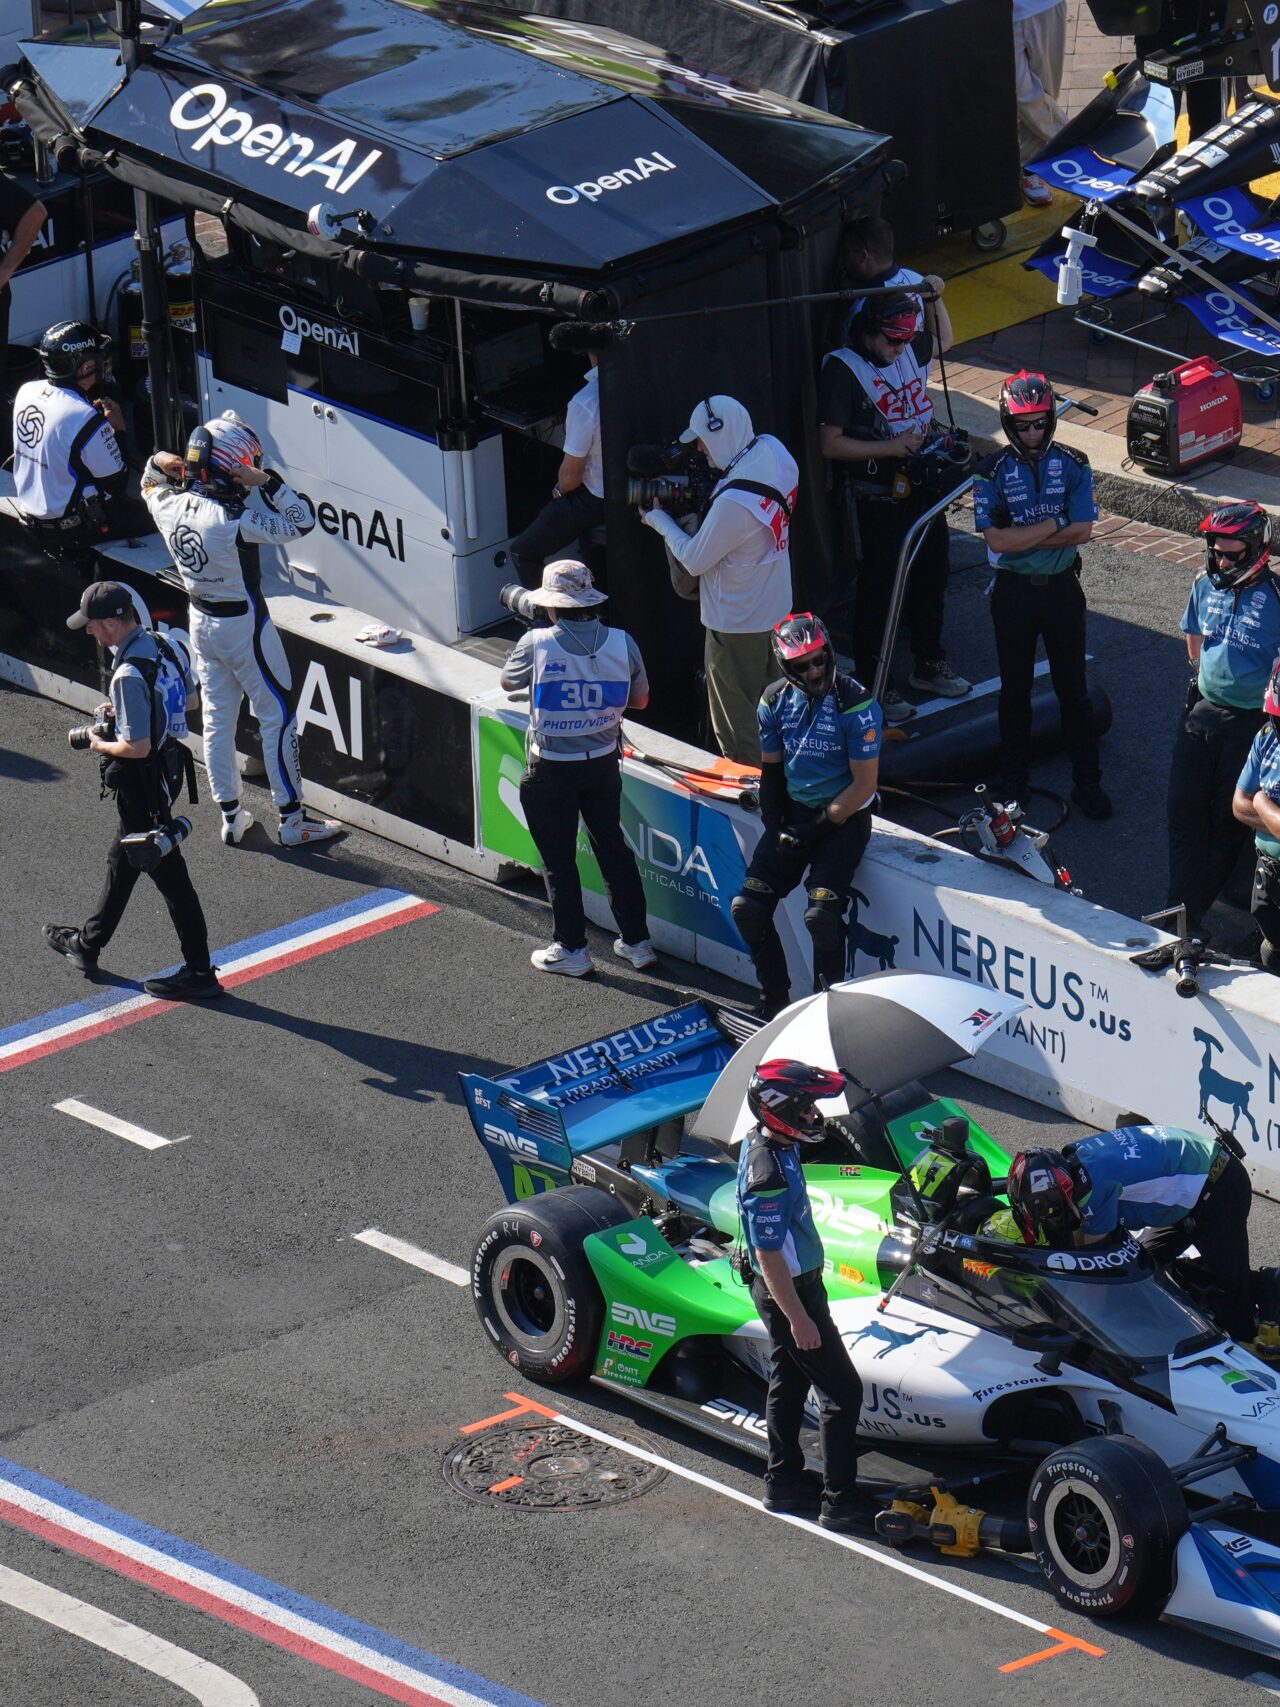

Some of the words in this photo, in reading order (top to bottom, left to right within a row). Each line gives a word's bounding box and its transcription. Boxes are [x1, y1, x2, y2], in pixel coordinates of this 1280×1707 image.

[1177, 66, 1203, 80] HYBRID
[169, 83, 383, 194] OpenAI
[545, 151, 677, 205] OpenAI
[278, 305, 360, 357] OpenAI
[61, 338, 96, 352] OpenAI
[1138, 404, 1160, 414] HONDA
[1200, 395, 1228, 412] HONDA
[560, 683, 603, 709] 30
[474, 1088, 483, 1097] BE
[758, 1088, 788, 1108] 47
[474, 1098, 492, 1110] BEST
[572, 1165, 596, 1182] HYBRID
[839, 1166, 861, 1177] HRC
[502, 1221, 520, 1237] R4
[473, 1229, 499, 1299] Firestone
[551, 1297, 577, 1368] Firestone
[607, 1331, 654, 1359] HRC
[602, 1368, 642, 1385] Firestone
[973, 1376, 1049, 1402] Firestone
[1046, 1462, 1100, 1483] Firestone
[1060, 1585, 1114, 1607] Firestone
